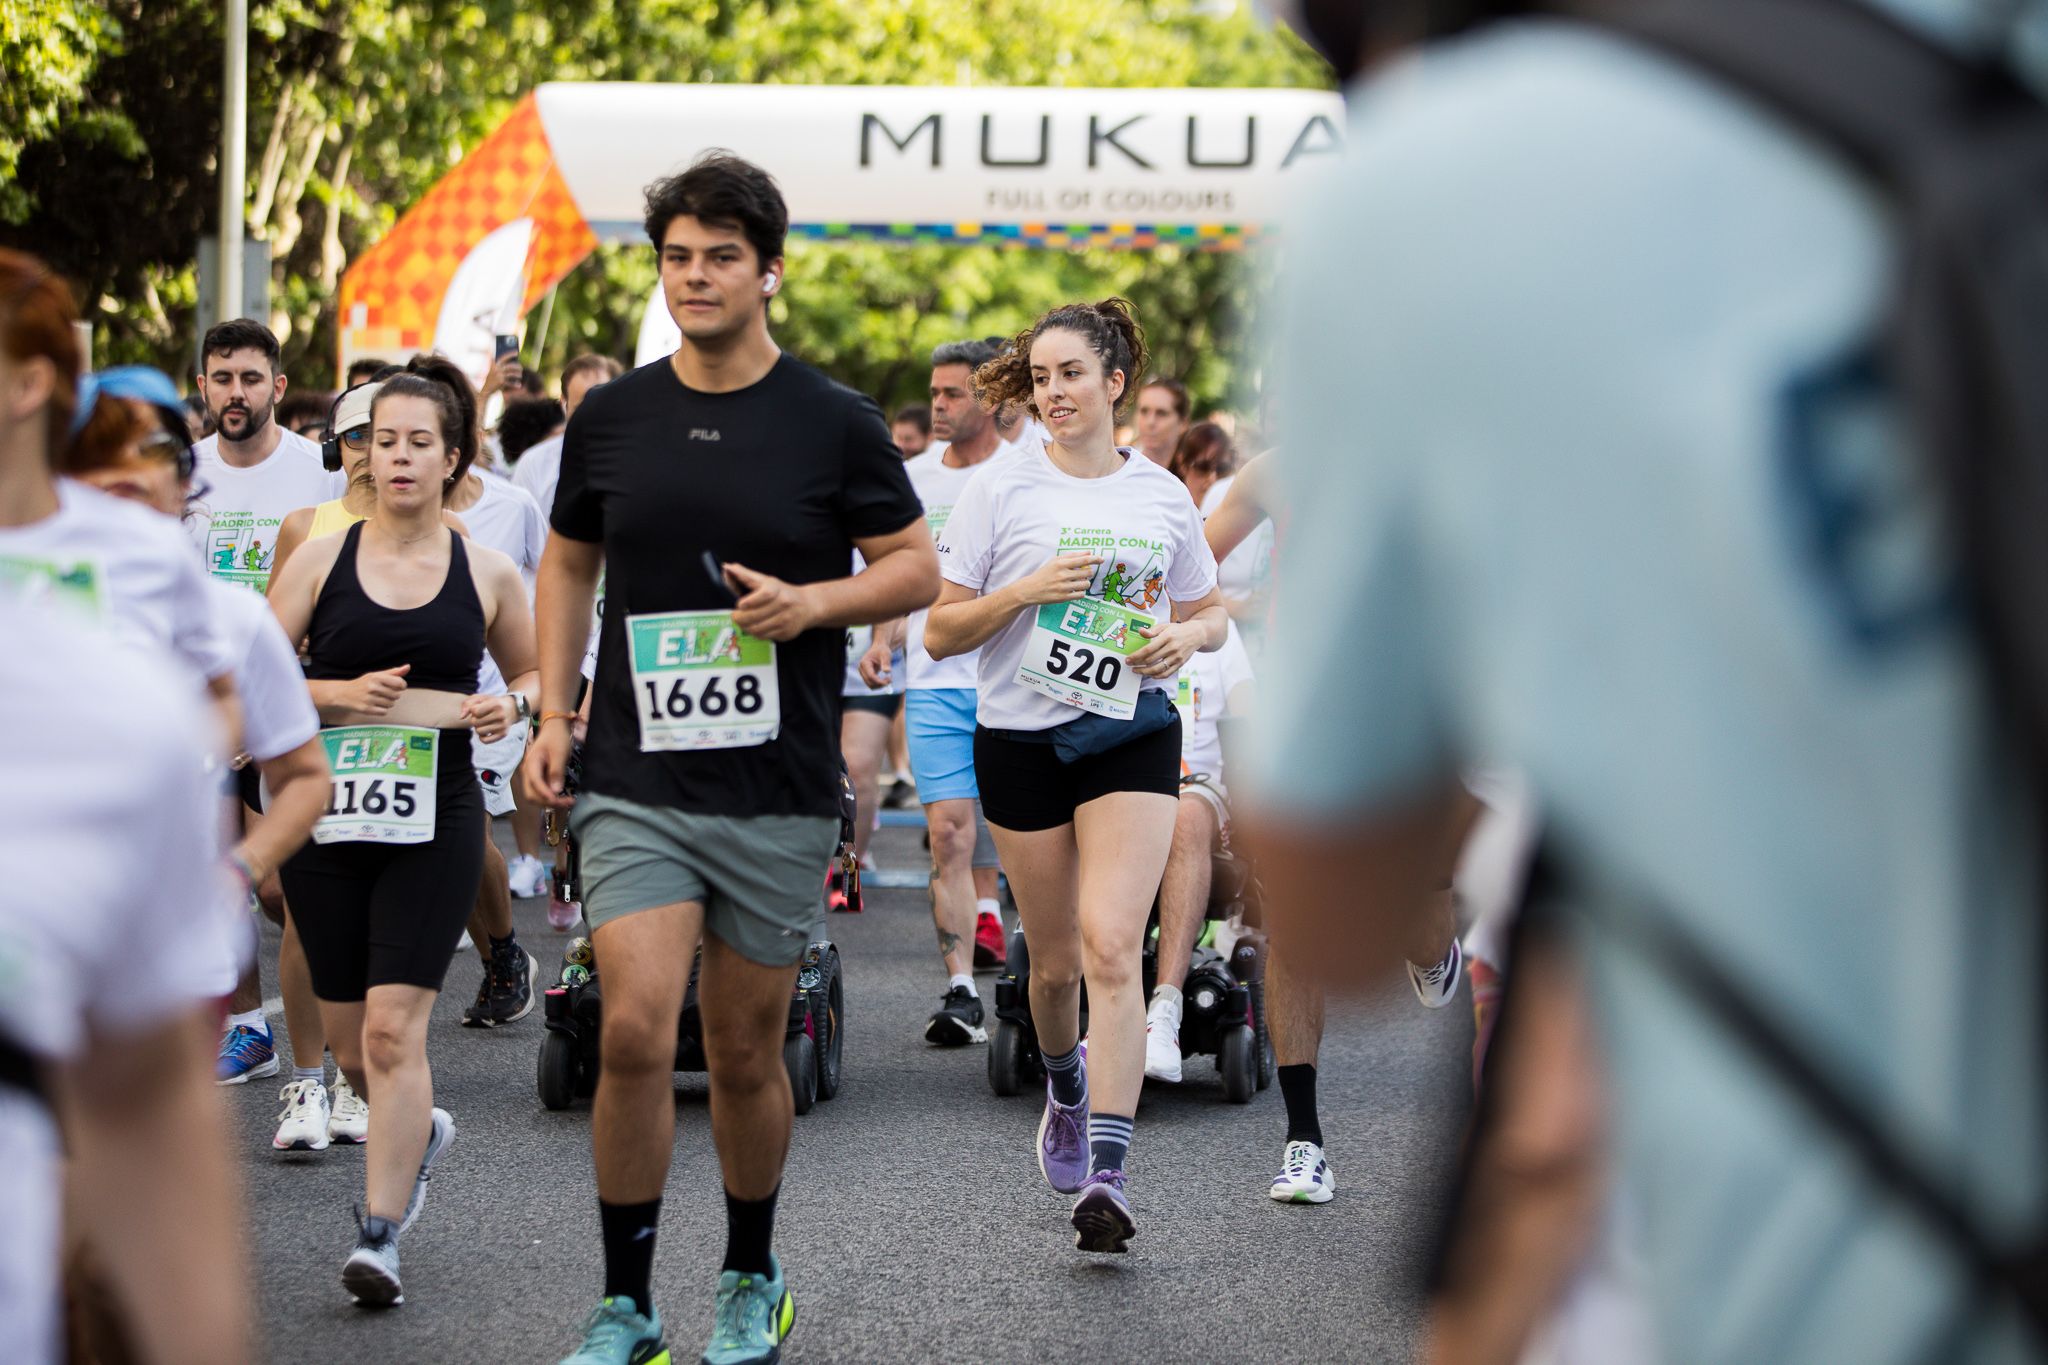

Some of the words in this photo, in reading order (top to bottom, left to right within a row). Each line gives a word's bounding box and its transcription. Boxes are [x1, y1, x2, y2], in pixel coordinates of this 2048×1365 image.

[859, 112, 1346, 171] MUKUA
[987, 190, 1047, 211] FULL
[1059, 190, 1093, 211] OF
[1104, 189, 1235, 212] COLOURS
[688, 429, 721, 441] FILA
[210, 519, 255, 528] MADRID
[257, 519, 281, 527] CON
[1073, 527, 1112, 535] Carrera
[1059, 537, 1115, 547] MADRID
[1119, 537, 1148, 548] CON
[1151, 541, 1164, 553] LA
[1099, 606, 1116, 618] CON
[1059, 603, 1128, 650] ELA
[656, 626, 741, 667] ELA
[1046, 638, 1122, 691] 520
[645, 674, 763, 720] 1668
[335, 738, 409, 770] ELA
